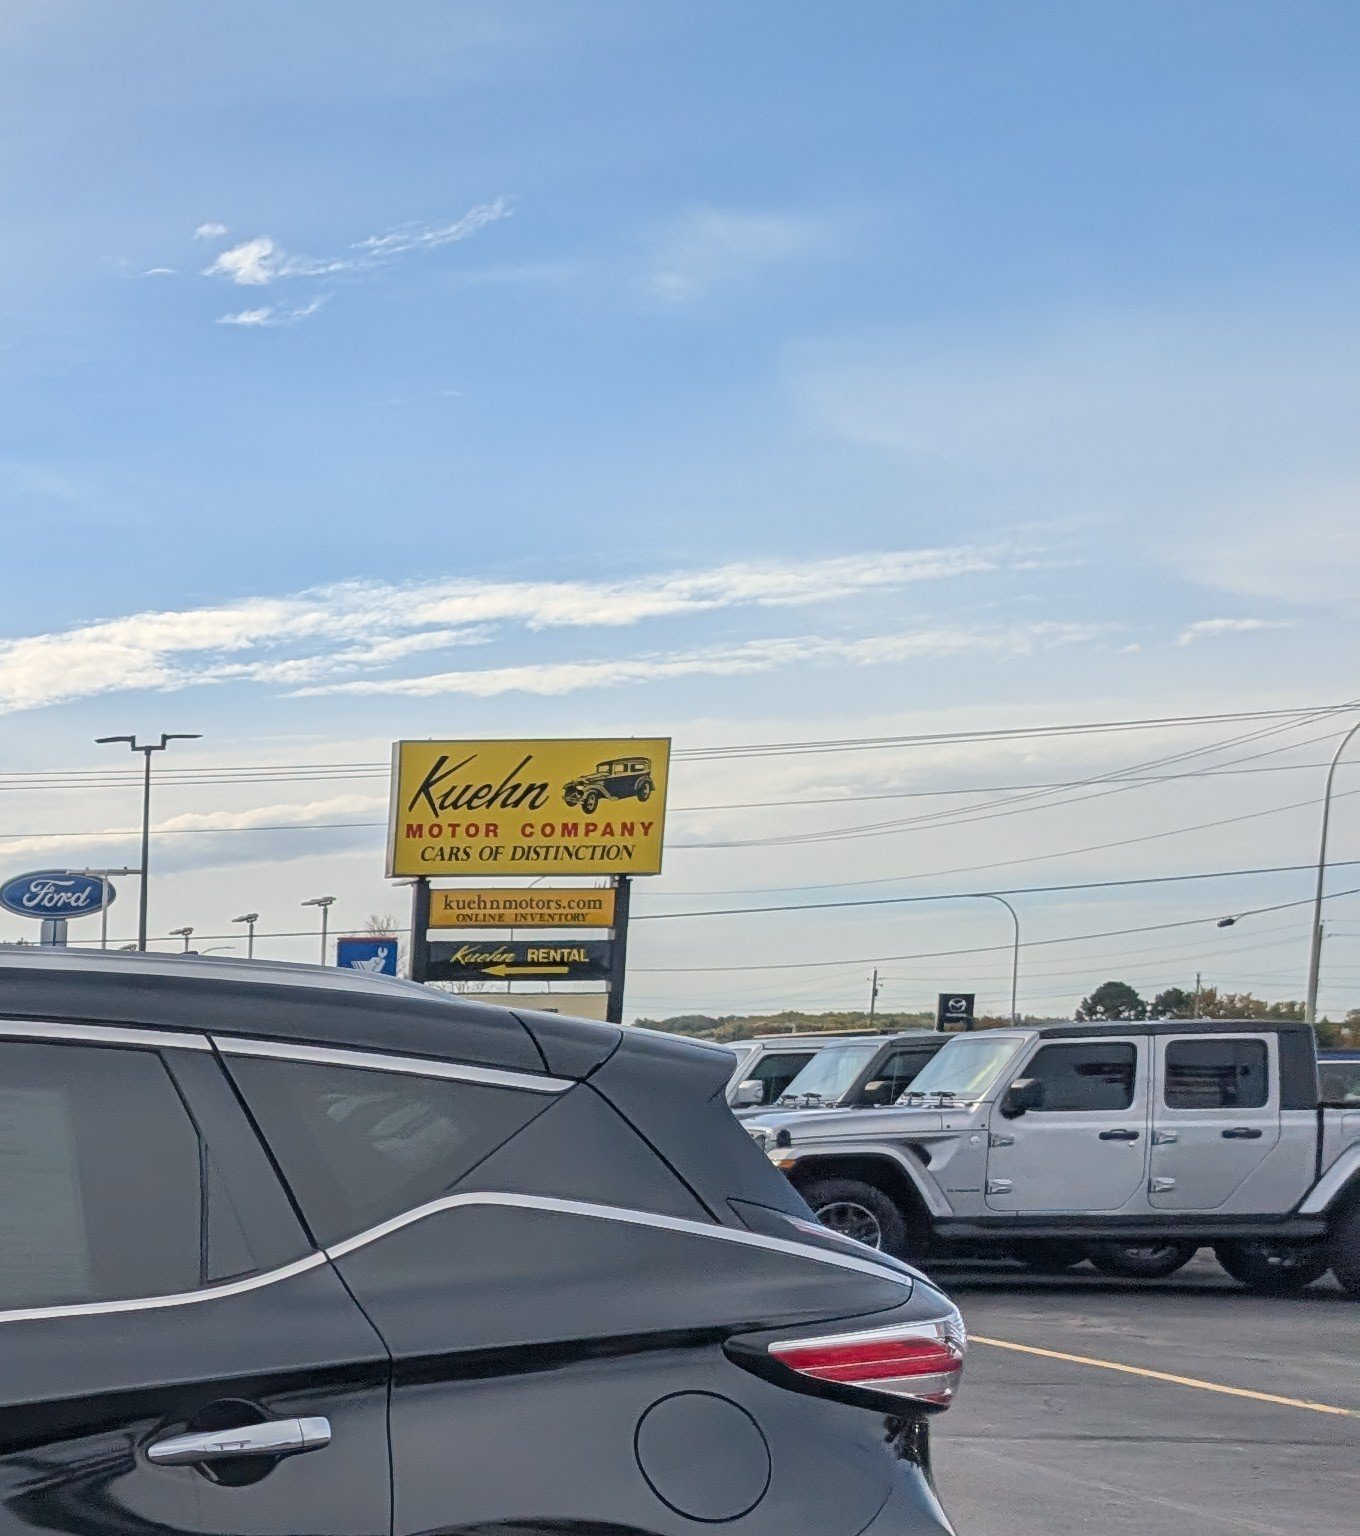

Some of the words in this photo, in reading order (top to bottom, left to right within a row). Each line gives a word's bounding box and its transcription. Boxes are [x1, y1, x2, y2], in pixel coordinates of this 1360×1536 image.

[408, 753, 549, 819] Kuehn
[405, 822, 499, 839] MOTOR
[520, 821, 654, 838] COMPANY
[420, 846, 472, 862] CARS
[479, 846, 504, 862] OF
[509, 844, 635, 862] DISTINCTION
[22, 880, 92, 907] Ford
[442, 894, 603, 911] kuehnmotors.com
[456, 913, 505, 923] ONLINE
[514, 912, 589, 923] INVENTORY
[450, 945, 516, 965] Kuehn
[526, 949, 589, 963] RENTAL
